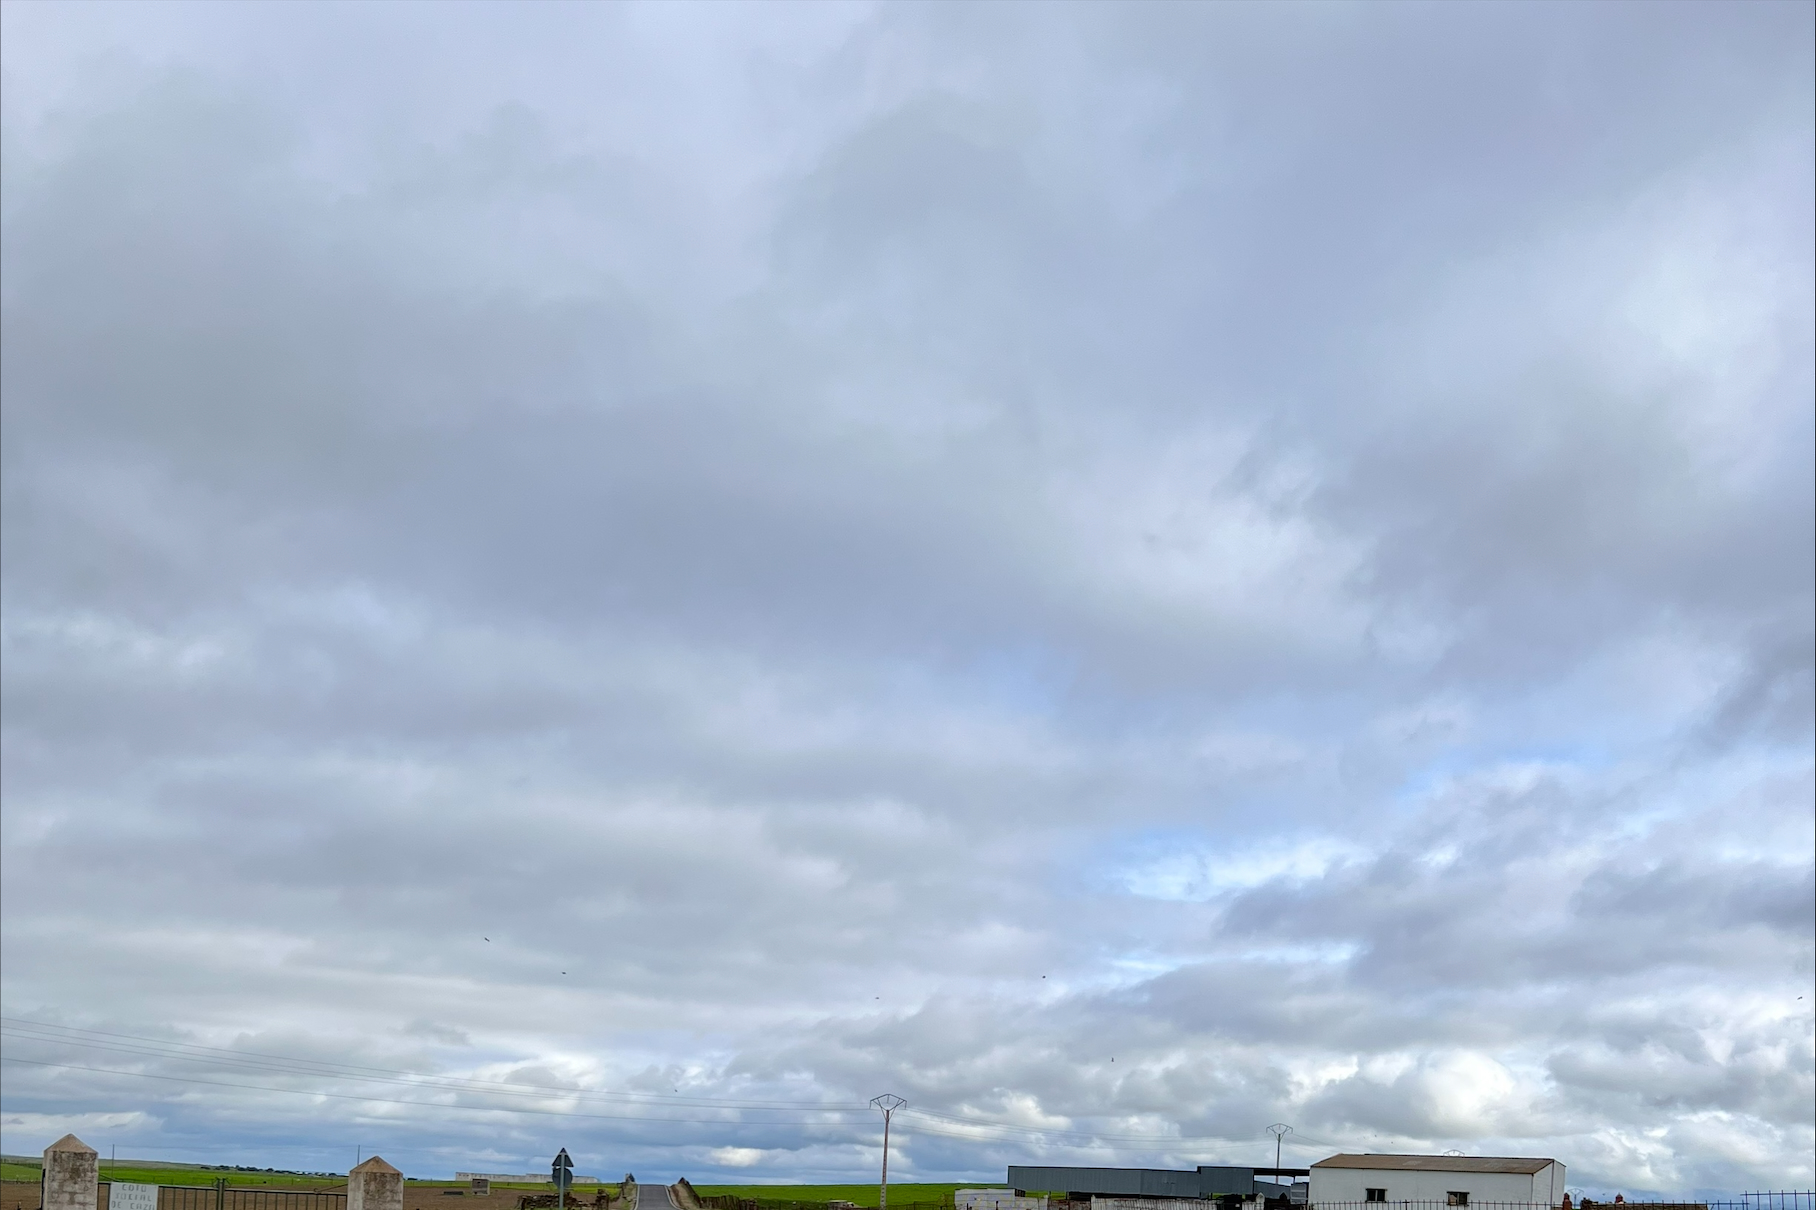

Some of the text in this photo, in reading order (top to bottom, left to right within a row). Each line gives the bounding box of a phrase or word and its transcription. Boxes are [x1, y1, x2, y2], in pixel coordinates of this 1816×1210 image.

[122, 1184, 147, 1192] COTO
[115, 1193, 152, 1202] SOCIAL
[111, 1201, 155, 1210] DE CAZA
